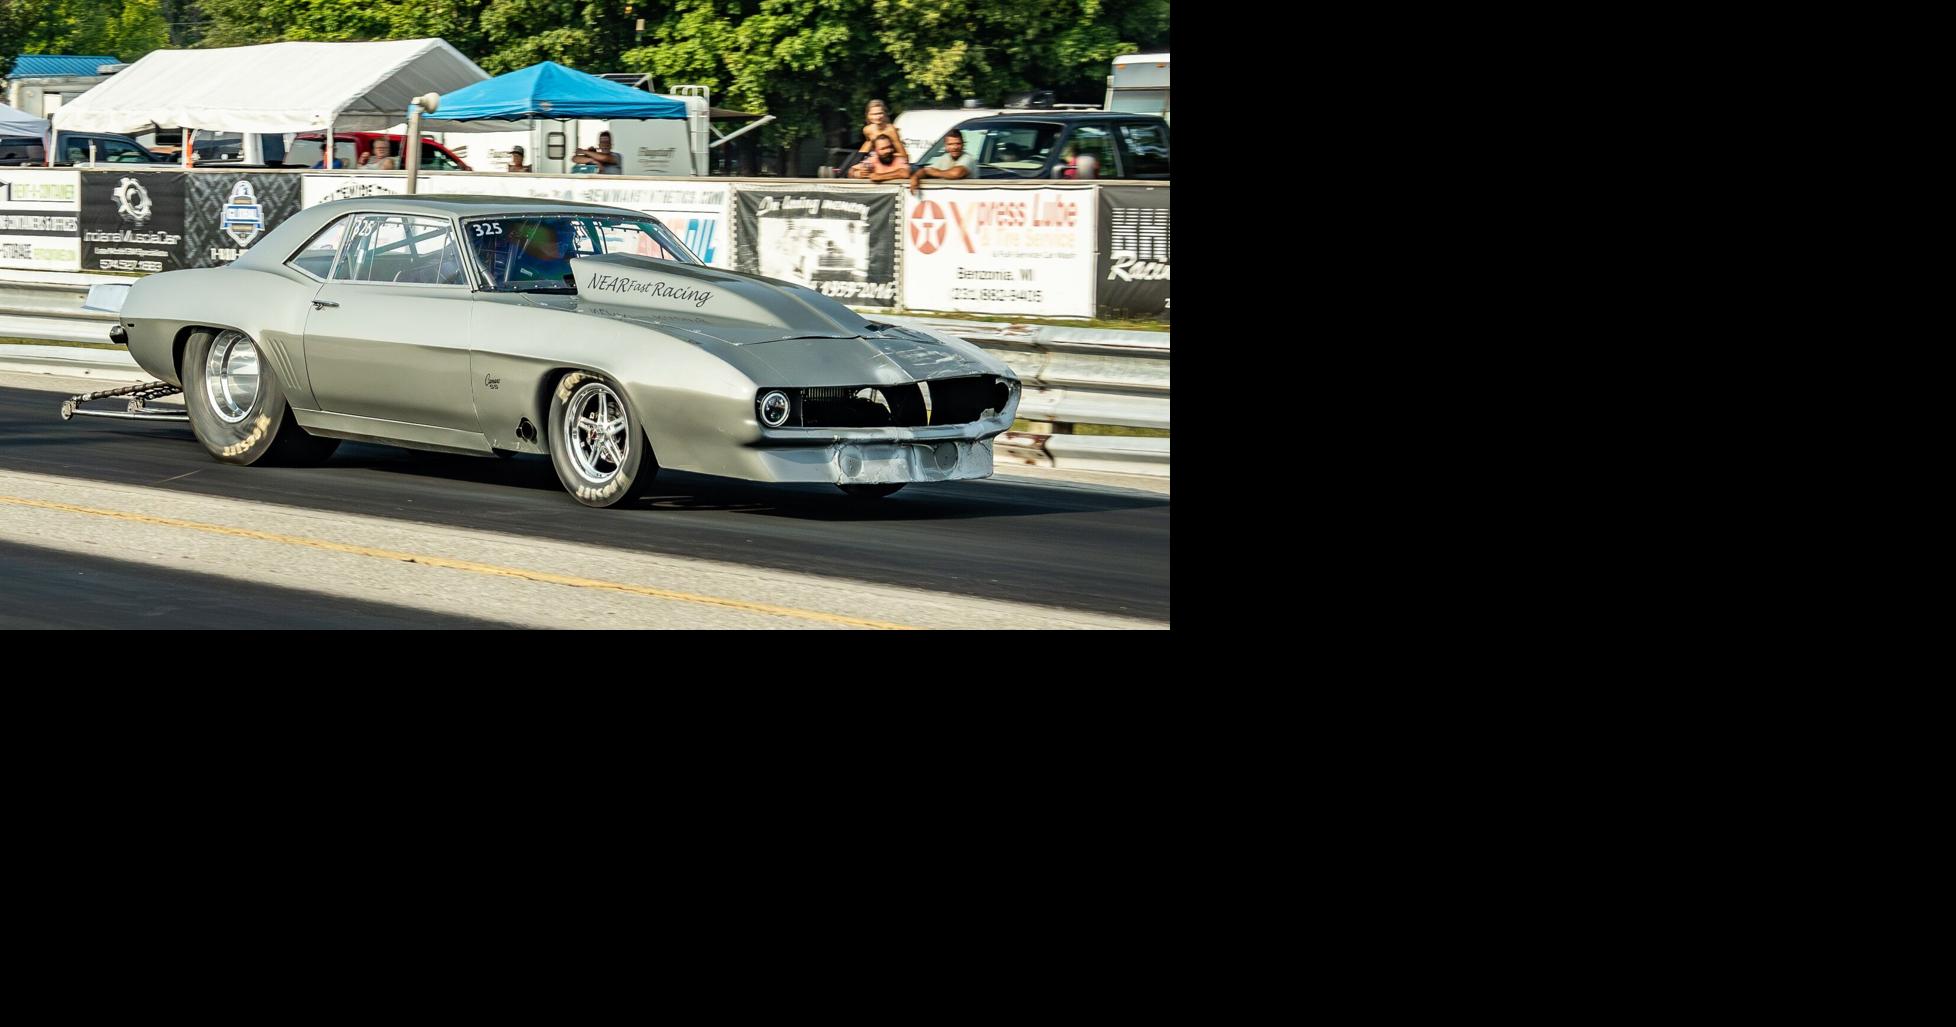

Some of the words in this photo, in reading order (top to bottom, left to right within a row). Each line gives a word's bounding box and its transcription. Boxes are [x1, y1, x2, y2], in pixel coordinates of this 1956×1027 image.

[472, 221, 503, 236] 325
[588, 272, 630, 294] NEAR
[627, 280, 654, 294] Fast
[651, 281, 714, 308] Racing
